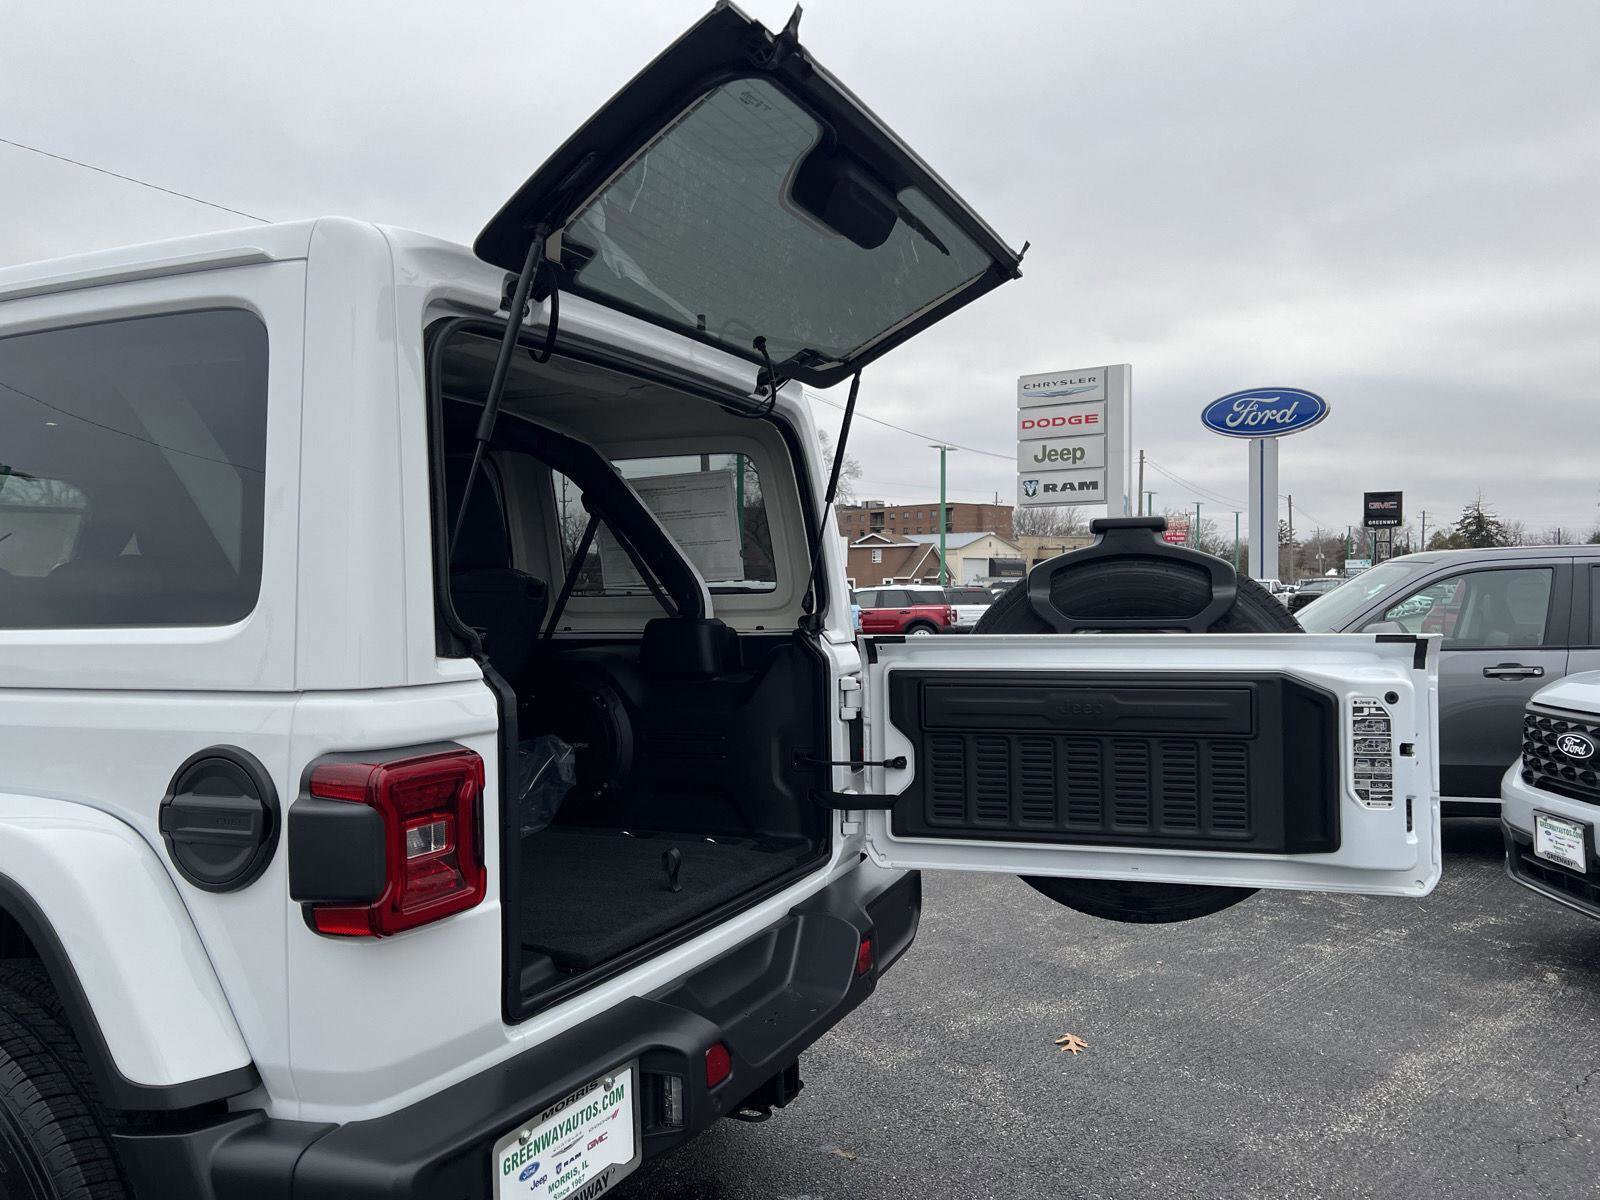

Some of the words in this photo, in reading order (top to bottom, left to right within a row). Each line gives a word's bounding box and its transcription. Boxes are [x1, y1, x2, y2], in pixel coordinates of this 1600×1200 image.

[1023, 377, 1096, 390] CHRYSLER
[1022, 414, 1099, 430] DODGE
[1225, 396, 1299, 428] Ford
[1033, 444, 1086, 465] Jeep
[1043, 481, 1098, 493] RAM
[1368, 501, 1397, 509] GMC
[1563, 736, 1586, 755] Ford
[541, 1079, 599, 1122] MORRIS
[503, 1084, 625, 1176] GREENWAYAUTOS.COM
[530, 1174, 548, 1191] Jeep
[563, 1152, 582, 1168] RAM
[587, 1131, 608, 1151] GMC
[548, 1168, 580, 1194] MORRIS,
[582, 1160, 590, 1171] IL
[553, 1184, 571, 1200] Since
